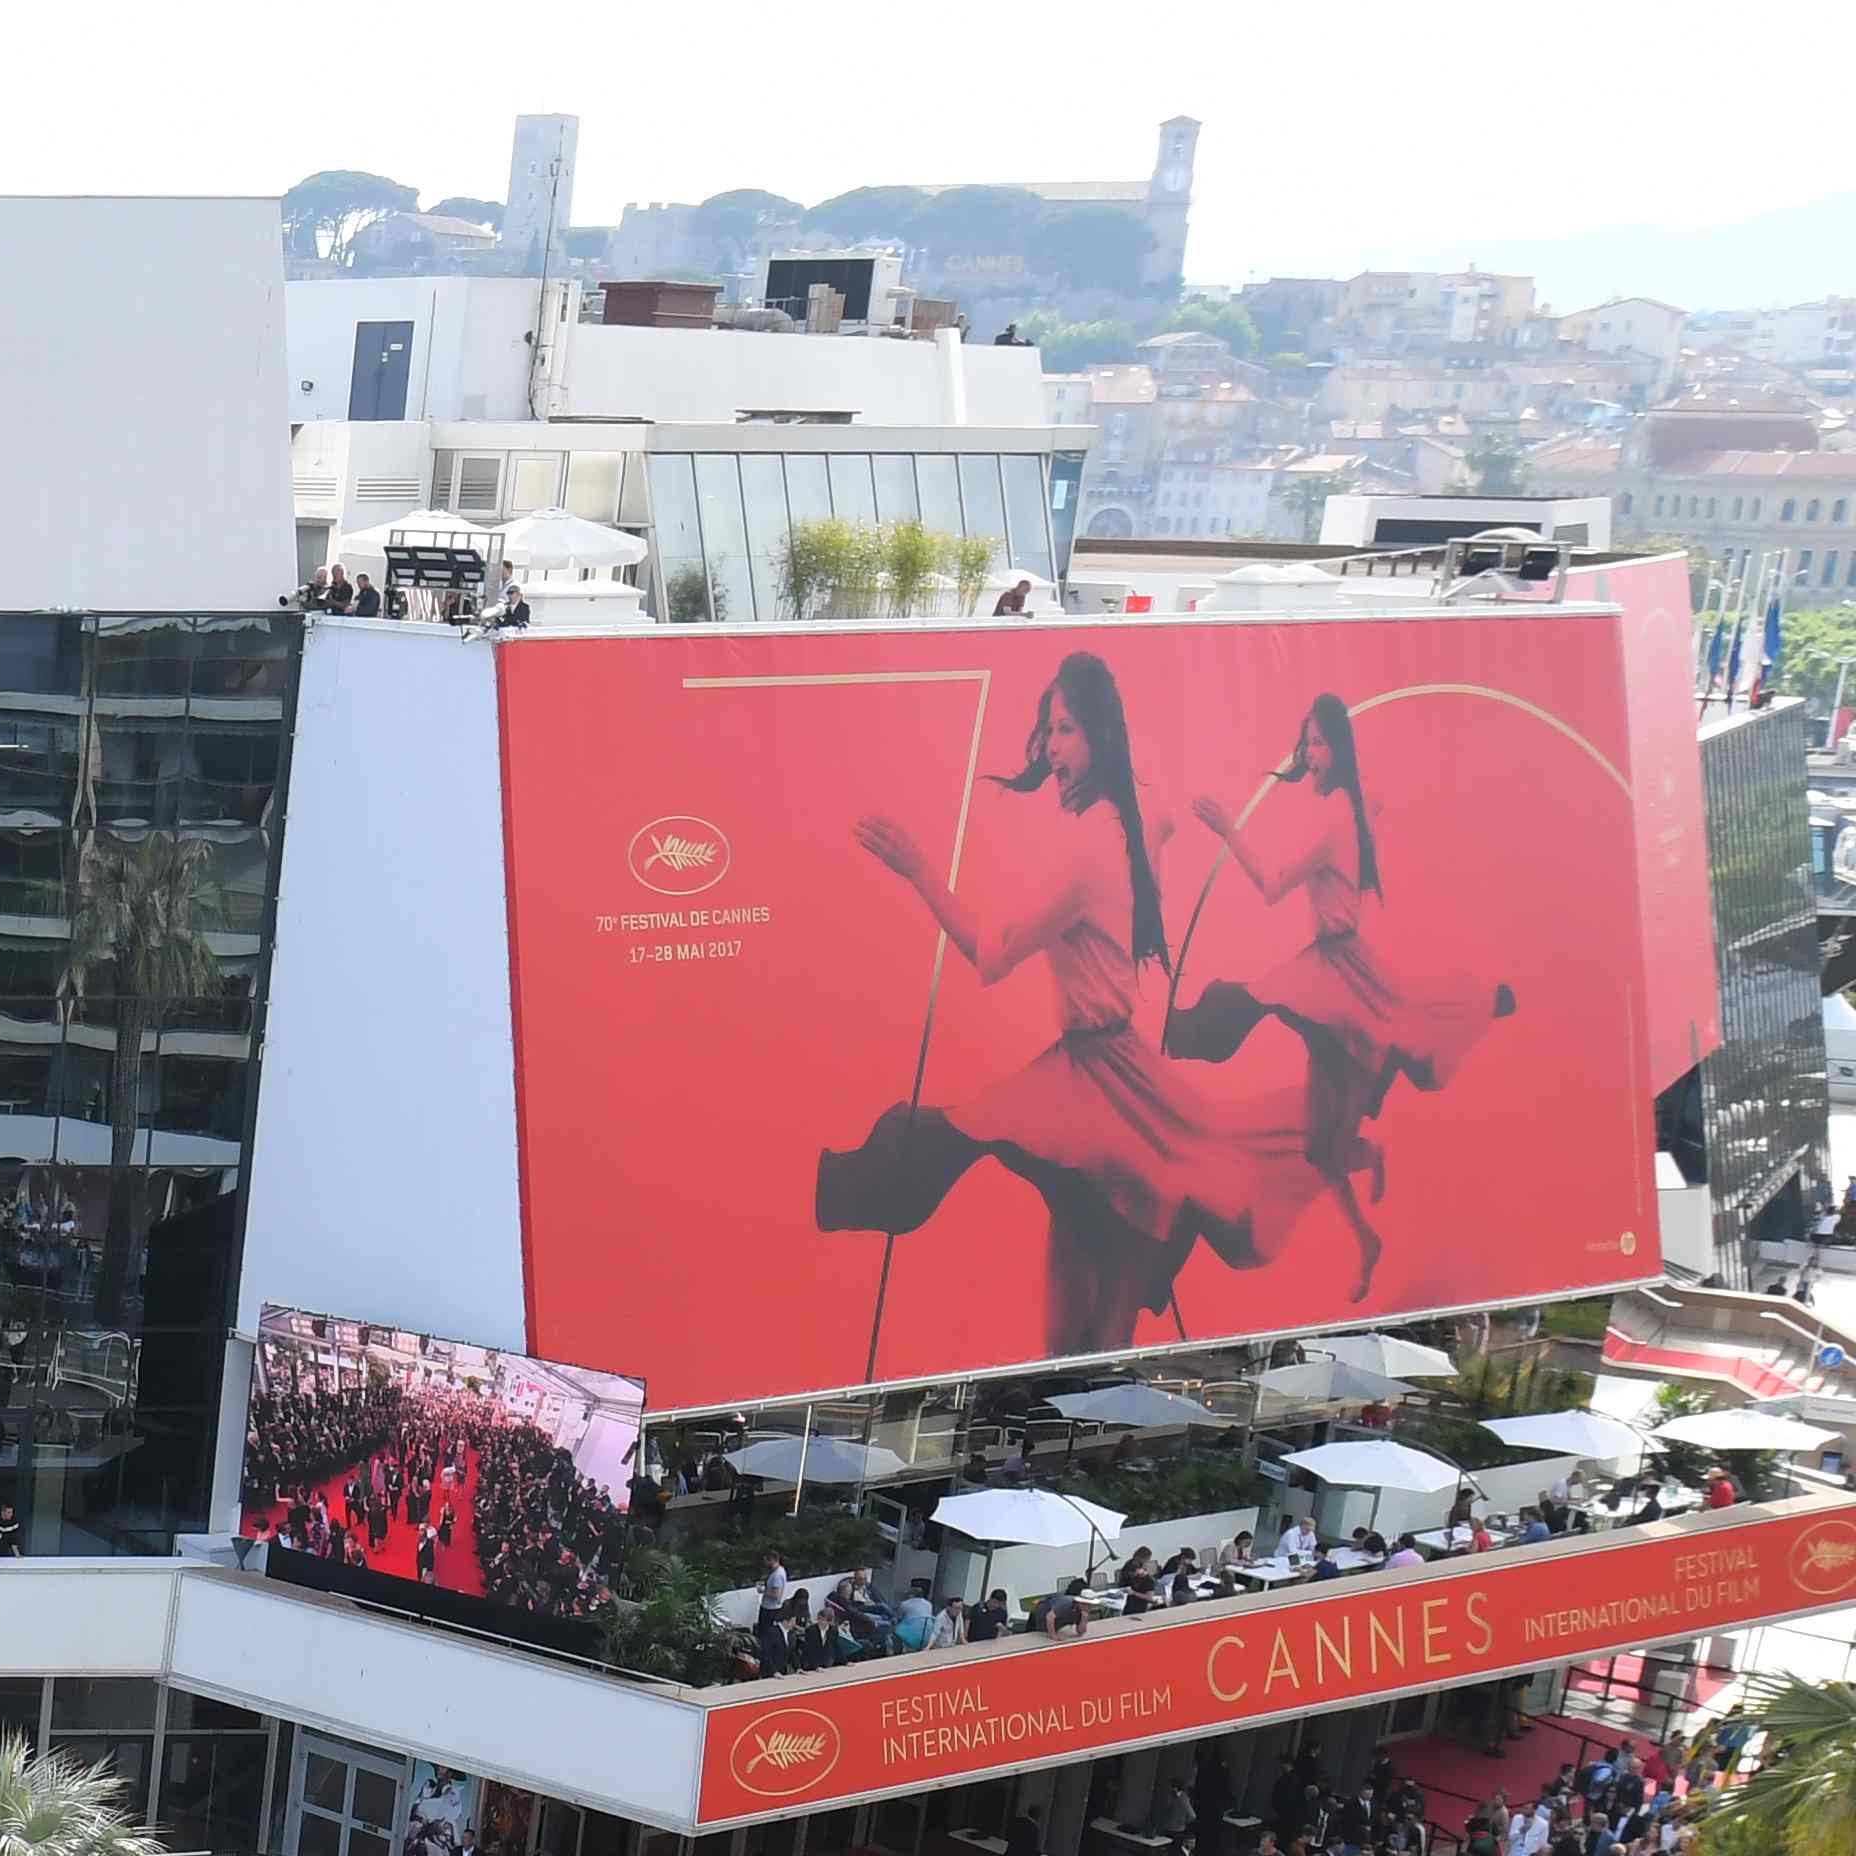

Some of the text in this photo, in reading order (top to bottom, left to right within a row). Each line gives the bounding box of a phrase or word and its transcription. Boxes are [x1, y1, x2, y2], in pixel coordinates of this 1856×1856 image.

[620, 912, 688, 931] FESTIVAL
[690, 910, 709, 927] DE
[712, 907, 770, 925] CANNES
[677, 943, 705, 961] MAI
[708, 940, 742, 959] 2017
[1674, 1546, 1759, 1583] FESTIVAL
[1524, 1577, 1761, 1643] INTERNATIONAL DU FILM
[1207, 1591, 1494, 1702] CANNES
[880, 1685, 989, 1729] FESTIVAL
[882, 1684, 1173, 1765] INTERNATIONAL DU FILM
